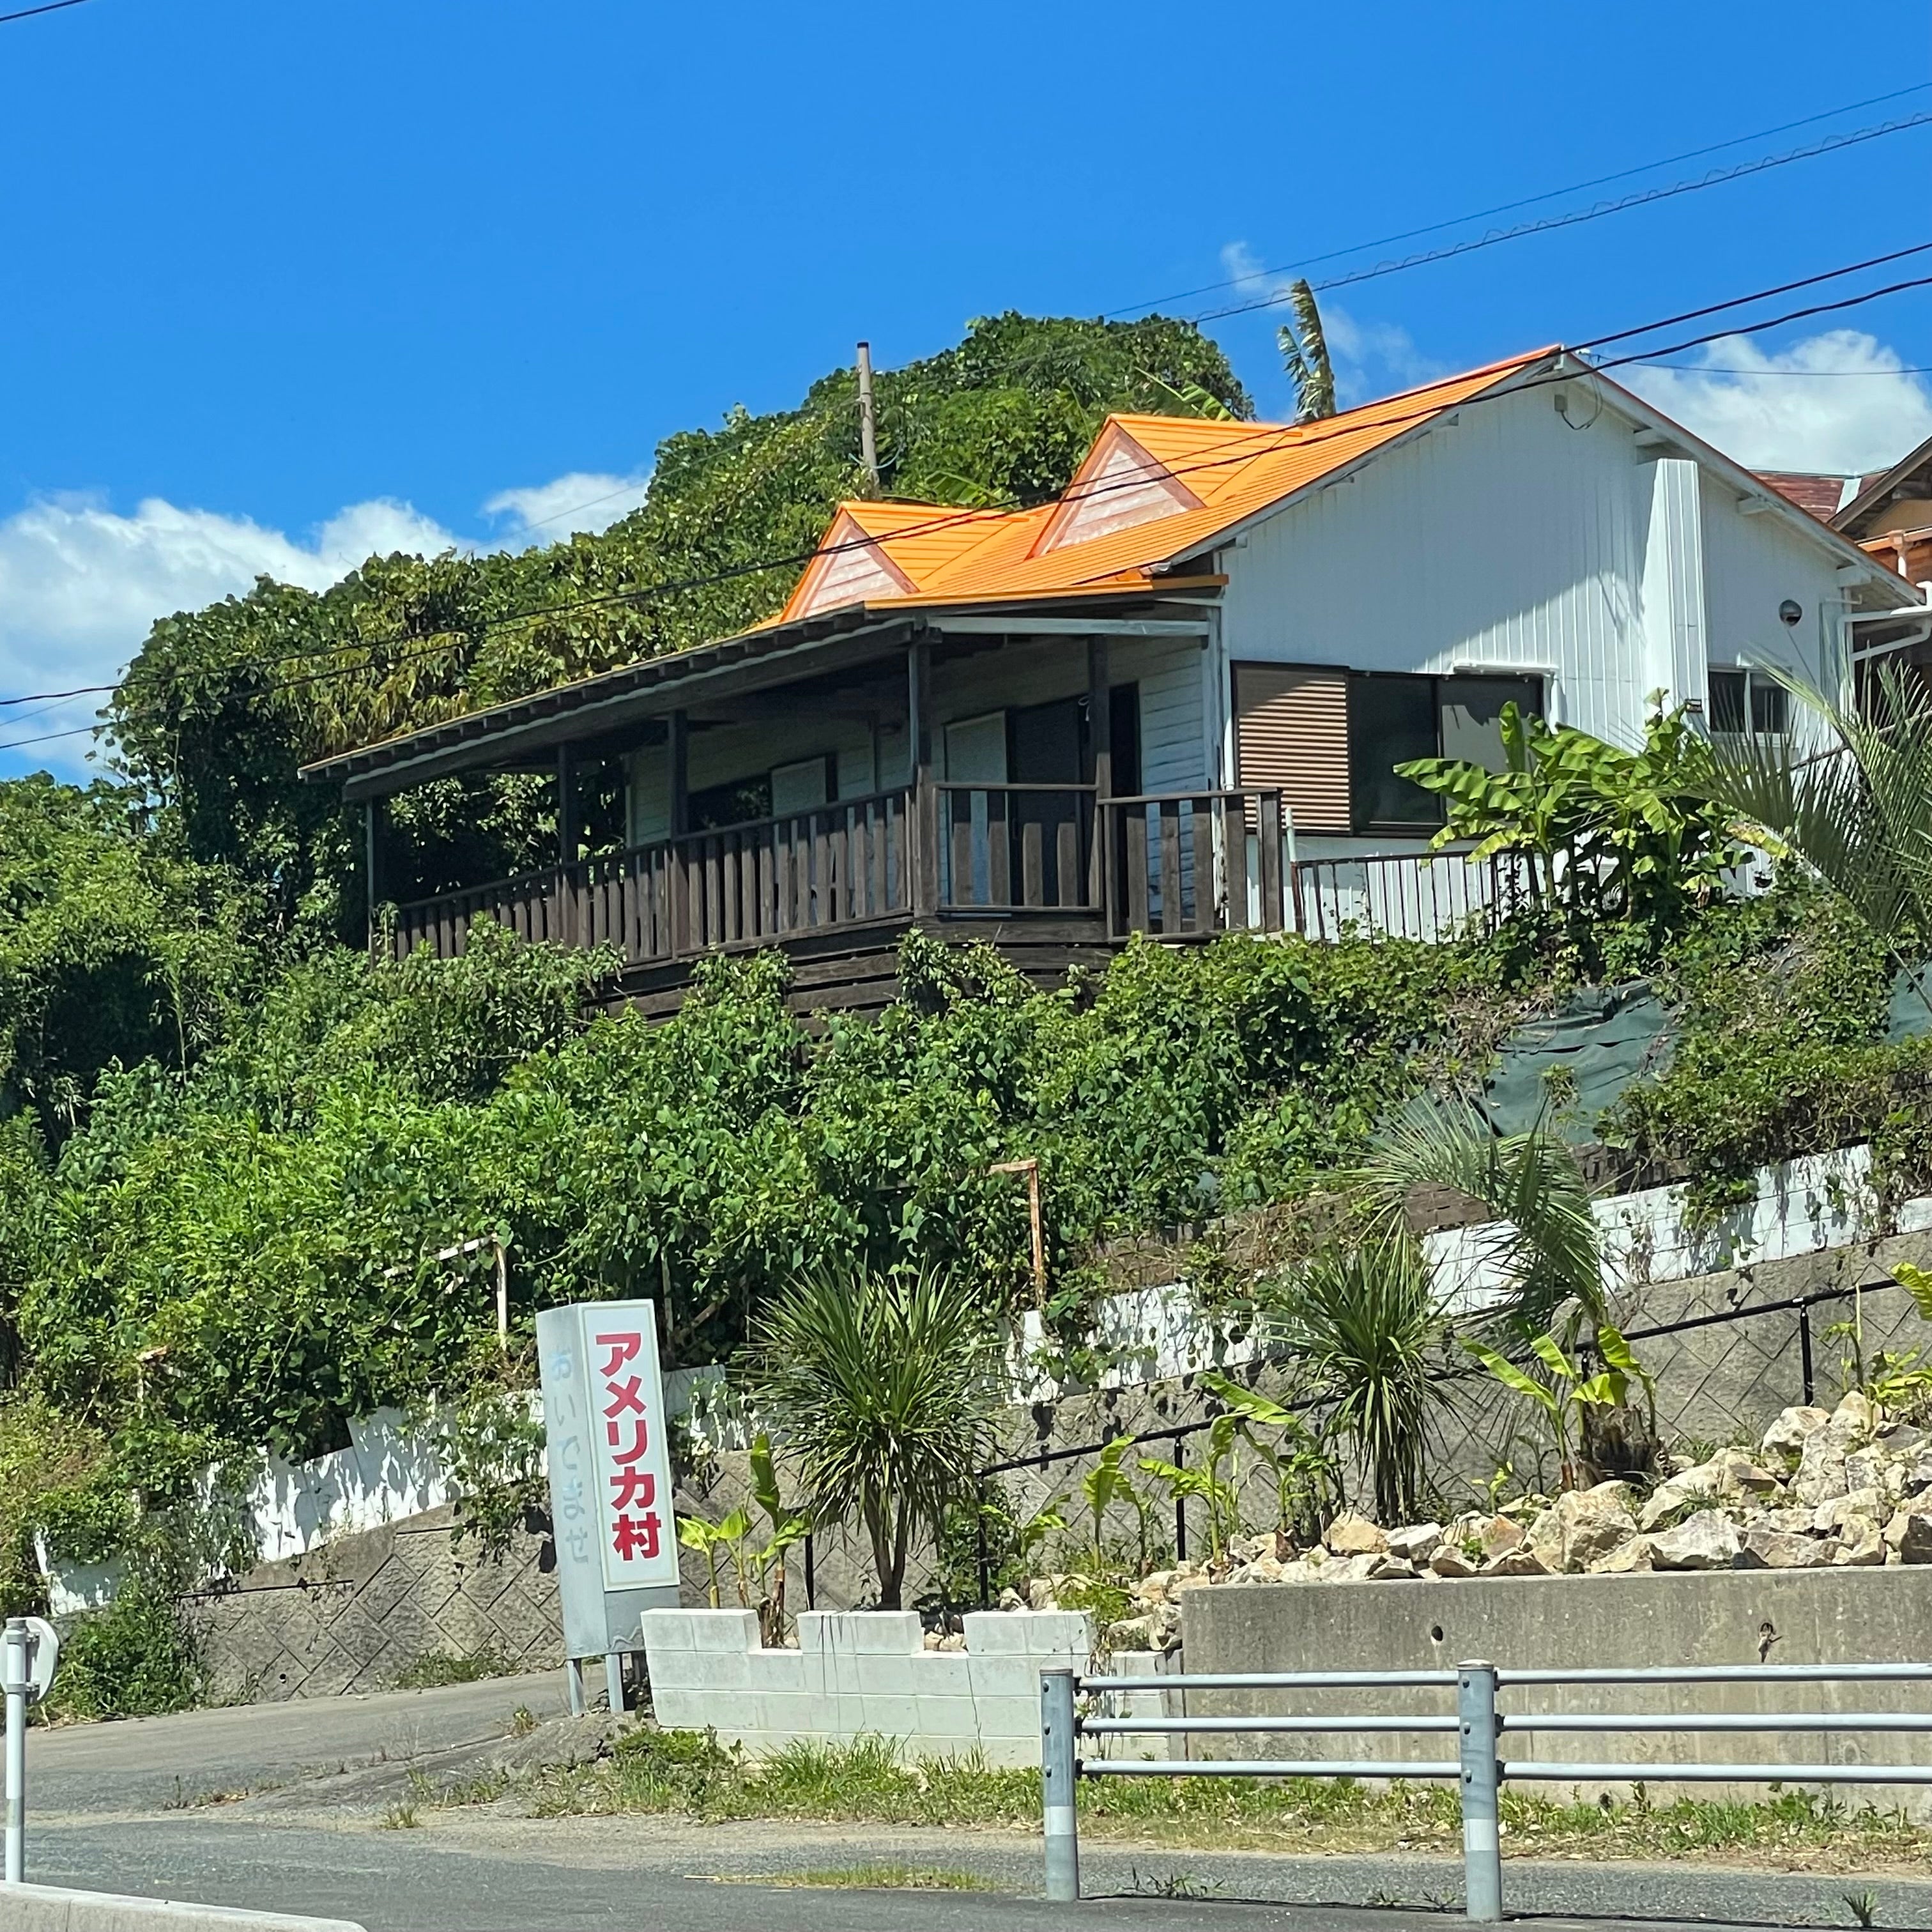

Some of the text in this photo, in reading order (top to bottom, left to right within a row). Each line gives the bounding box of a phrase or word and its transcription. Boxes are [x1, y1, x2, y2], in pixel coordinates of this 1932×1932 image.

[595, 1331, 662, 1561] アメリカ村
